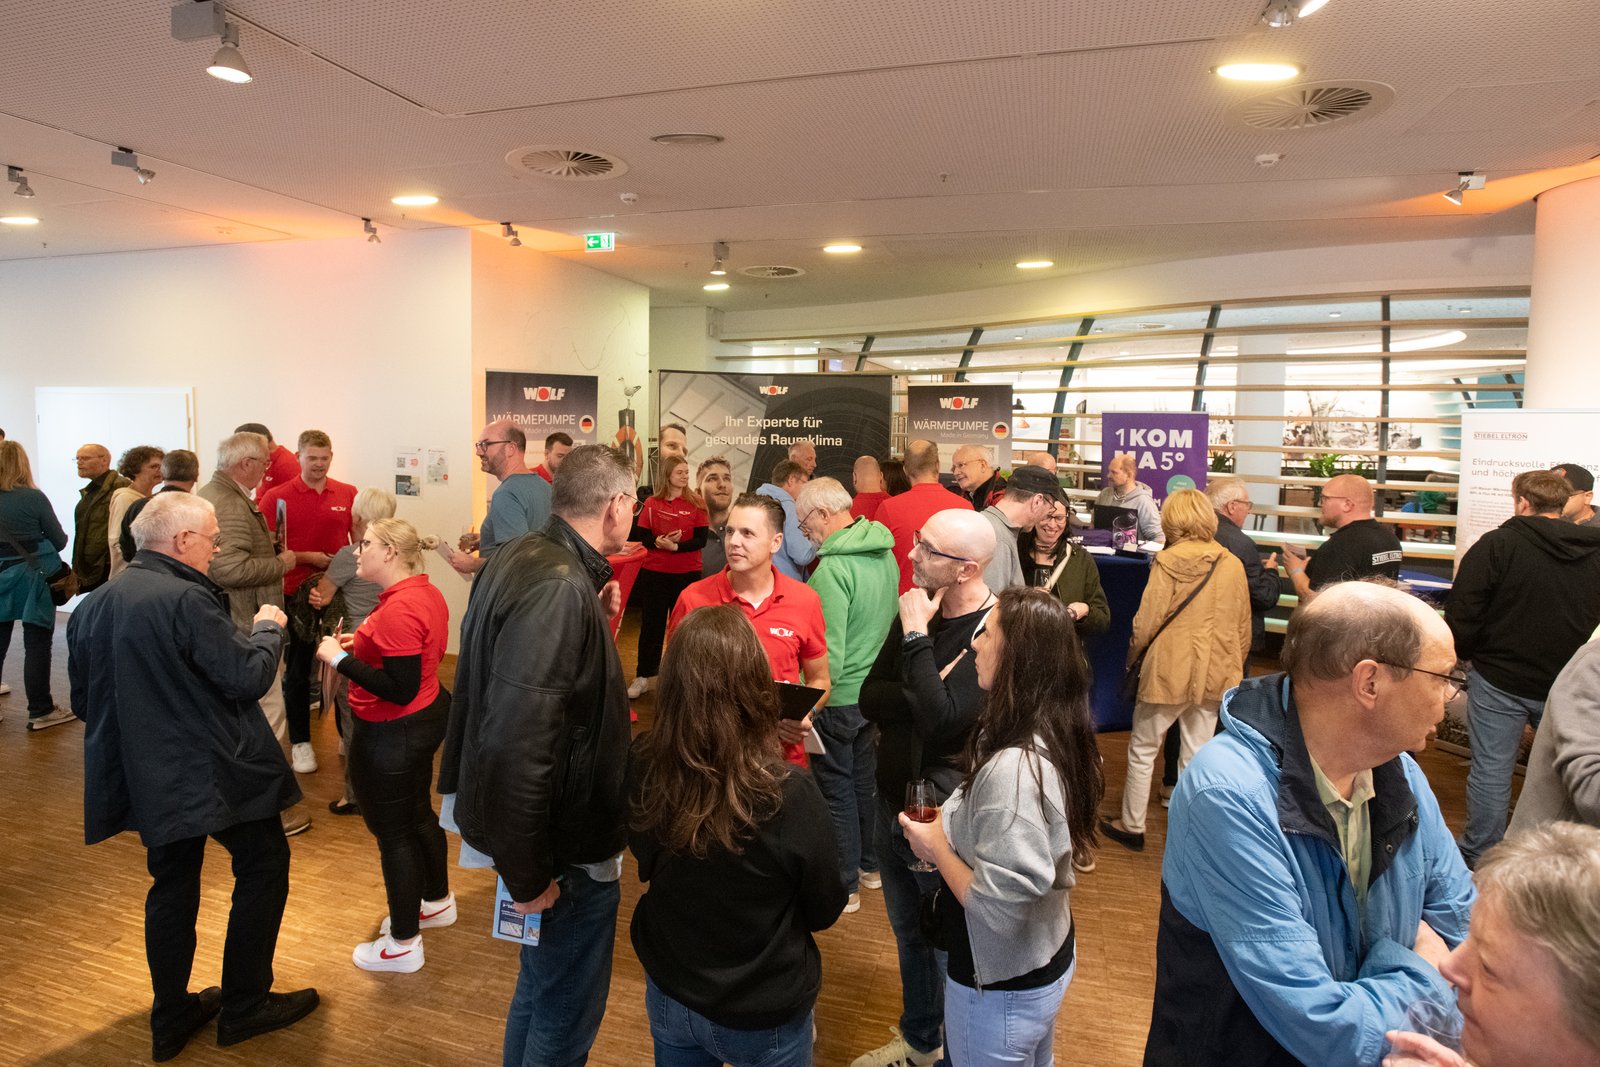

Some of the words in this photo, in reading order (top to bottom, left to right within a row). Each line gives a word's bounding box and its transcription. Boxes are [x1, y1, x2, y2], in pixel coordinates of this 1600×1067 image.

[523, 386, 565, 402] WOLF
[759, 385, 789, 396] WOLF
[939, 396, 979, 410] WOLF
[493, 411, 576, 425] WÄRMEPUMPE
[725, 416, 744, 427] Ihr
[747, 416, 799, 430] Experte
[802, 416, 823, 428] für
[913, 418, 989, 431] WÄRMEPUMPE
[705, 434, 767, 447] gesundes
[1472, 458, 1546, 469] Eindrucksvolle
[1471, 468, 1489, 477] und
[769, 627, 794, 637] WOLF
